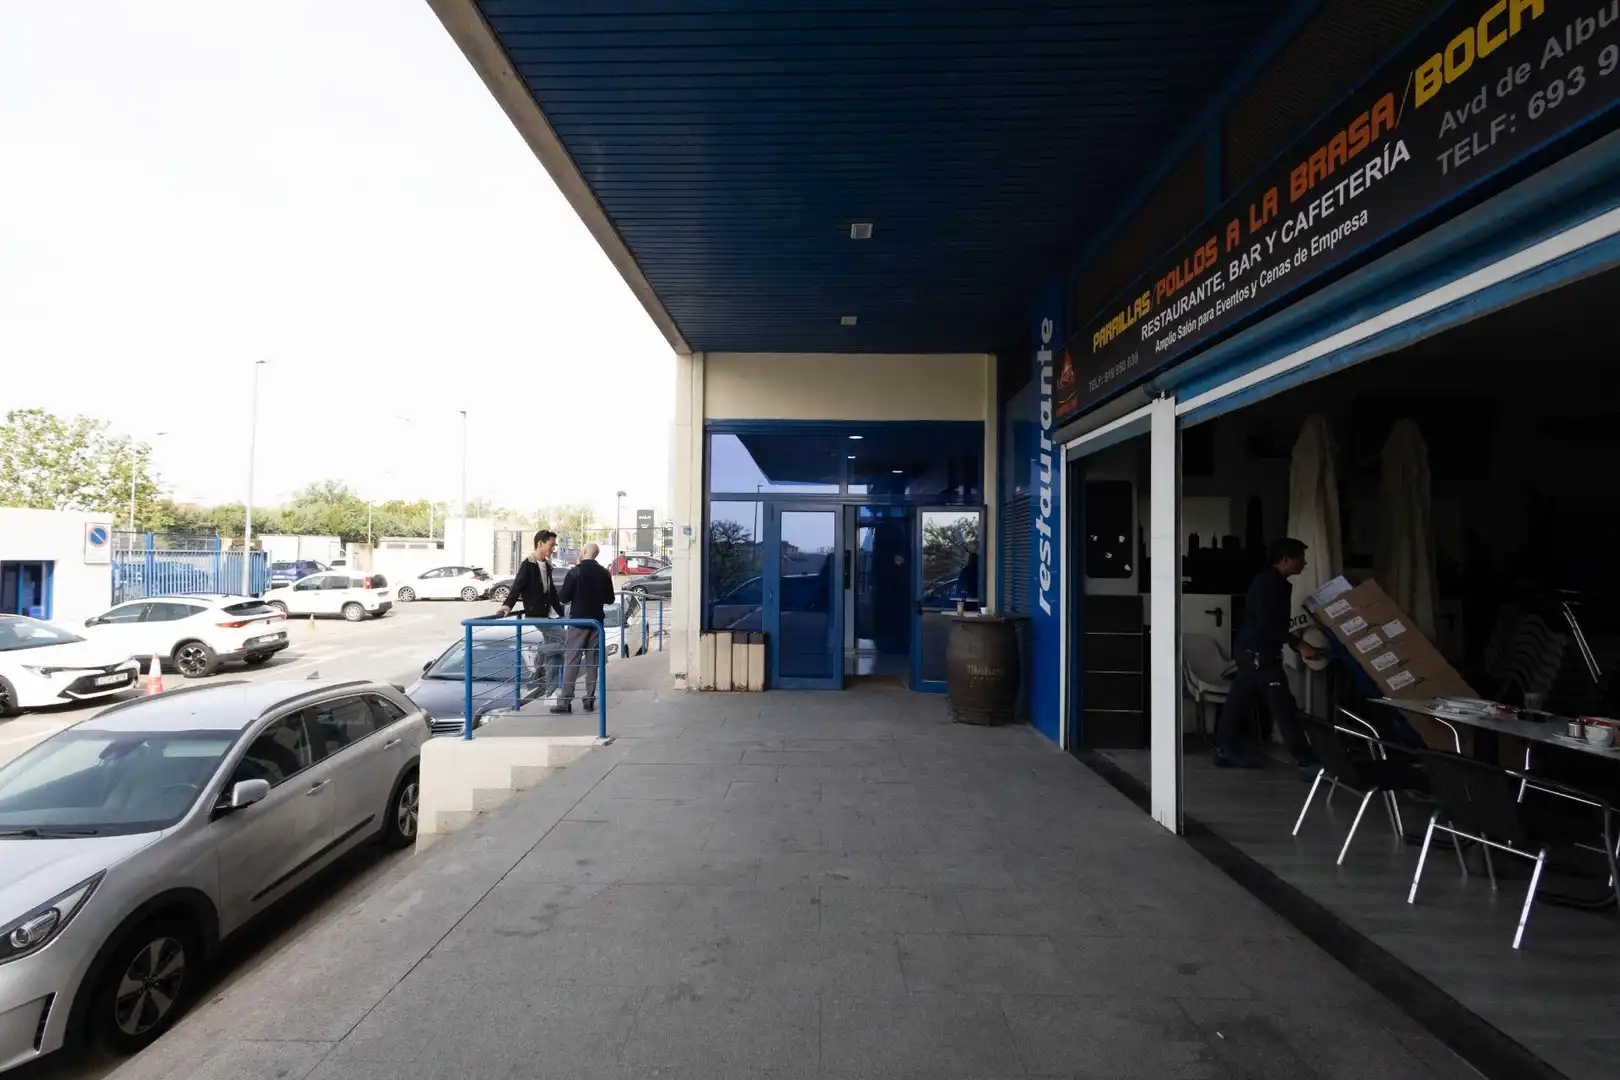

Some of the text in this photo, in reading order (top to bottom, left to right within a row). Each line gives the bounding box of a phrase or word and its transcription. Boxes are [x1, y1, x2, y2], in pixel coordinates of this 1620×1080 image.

[1437, 44, 1619, 176] TELF: 693 9
[1438, 85, 1487, 139] Avd
[1496, 62, 1531, 97] de
[1142, 139, 1411, 341] RESTAURANTE, BAR Y CAFETERÍA
[1155, 209, 1368, 353] Amplio Salón para Eventos y Cenas de Empresa
[1225, 218, 1239, 252] A
[1250, 186, 1278, 234] LA
[1036, 316, 1053, 616] restaurante
